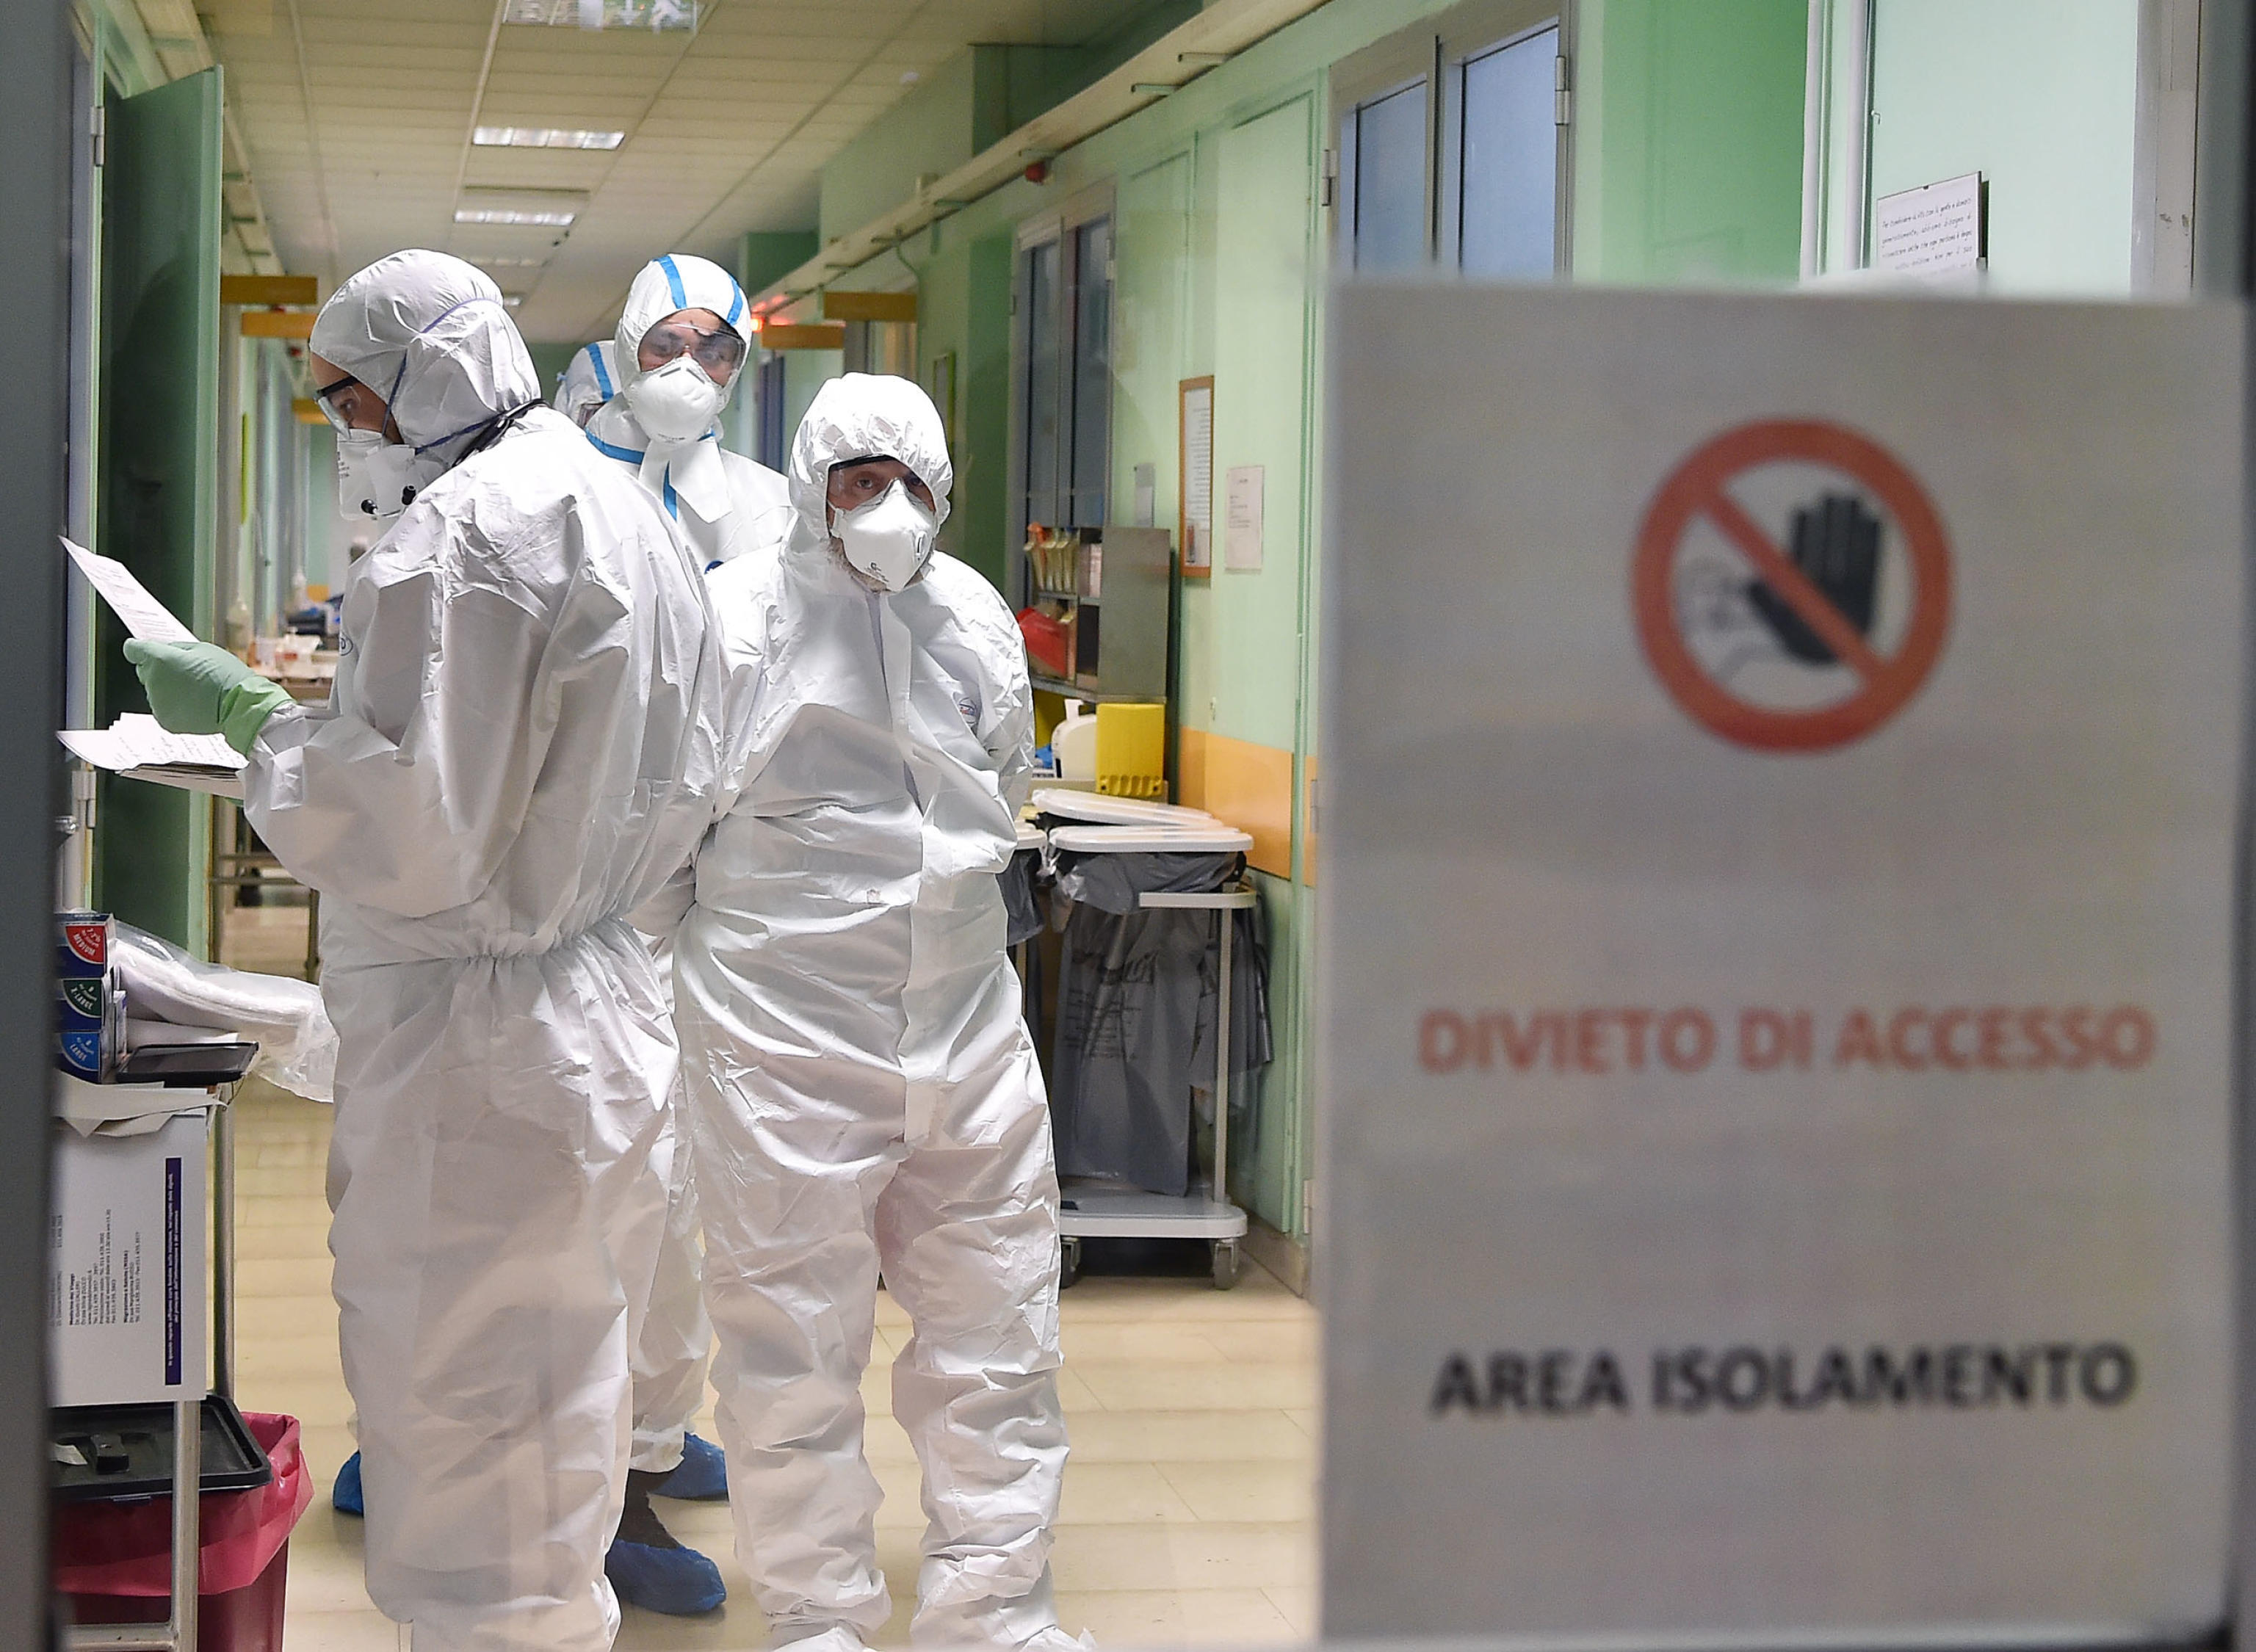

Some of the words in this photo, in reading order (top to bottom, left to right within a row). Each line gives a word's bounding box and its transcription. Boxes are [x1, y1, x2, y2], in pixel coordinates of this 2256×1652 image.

[1418, 1007, 1717, 1073] DIVIETO
[1738, 1007, 1812, 1073] DI
[1833, 1004, 2158, 1072] ACCESSO
[1430, 1351, 1627, 1416] AREA
[1651, 1341, 2137, 1412] ISOLAMENTO
